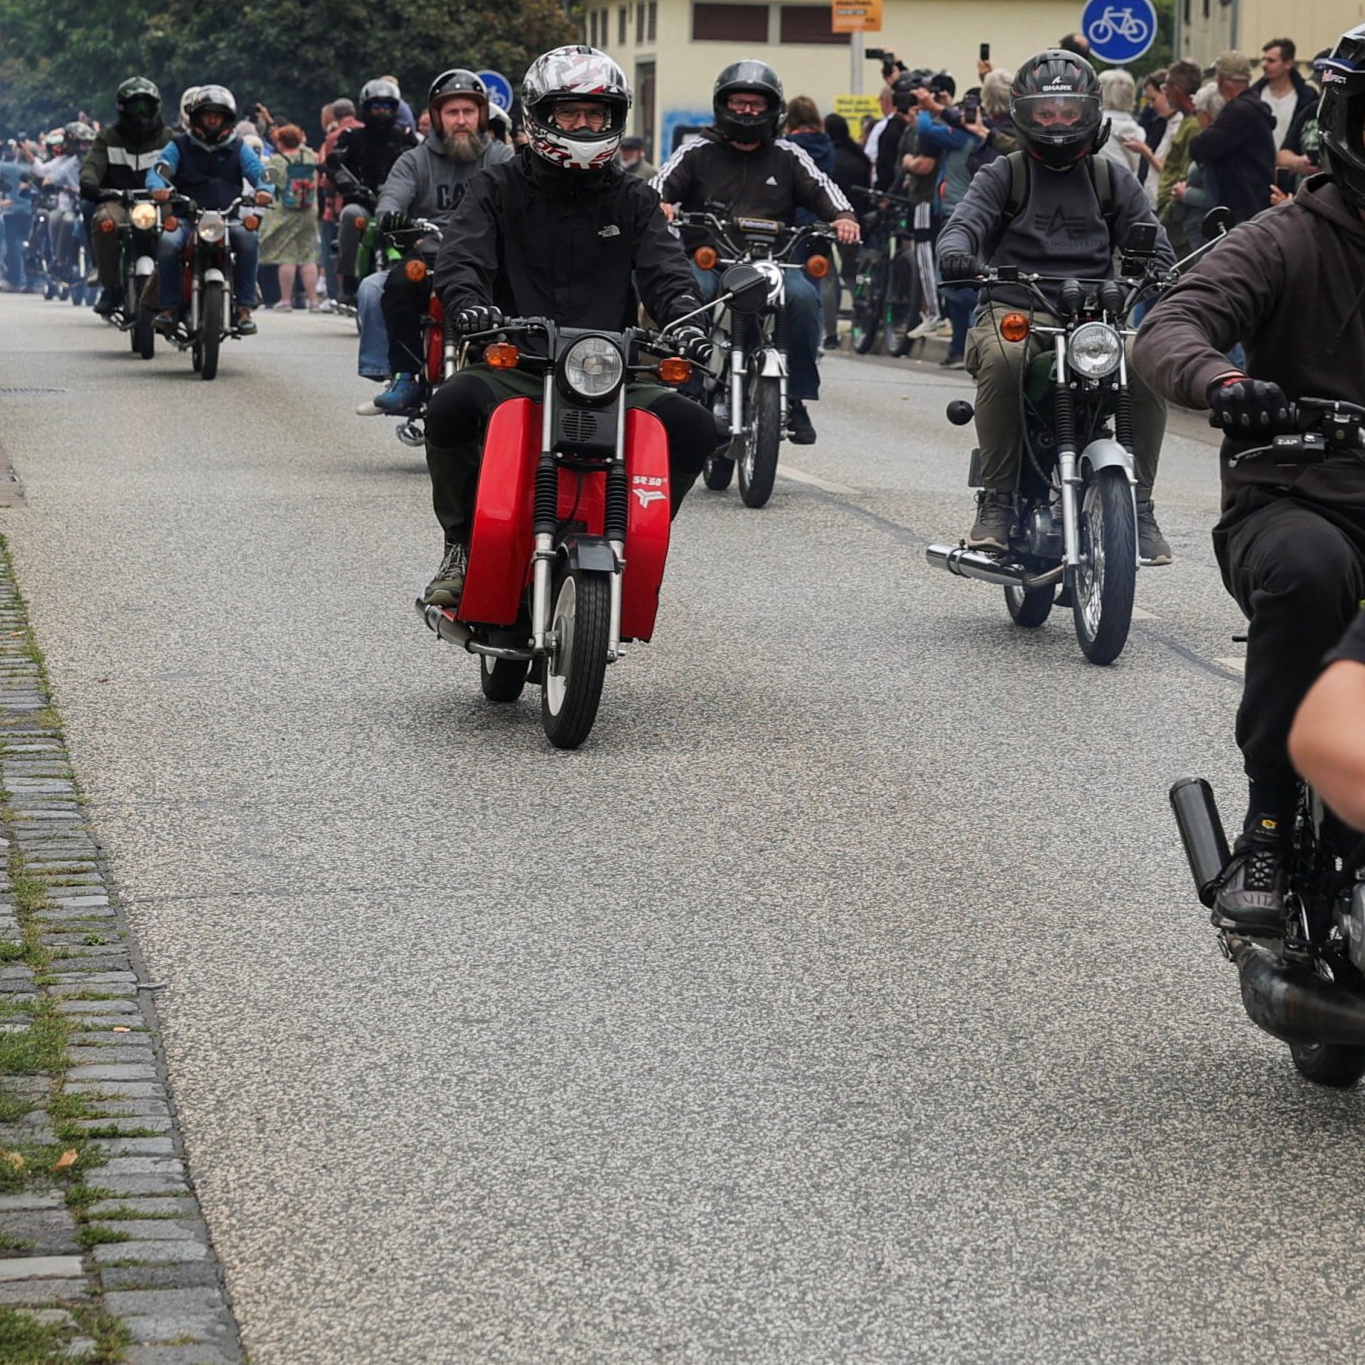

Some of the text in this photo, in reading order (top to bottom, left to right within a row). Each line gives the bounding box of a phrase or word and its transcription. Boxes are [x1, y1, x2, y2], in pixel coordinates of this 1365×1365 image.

[1042, 84, 1073, 92] SHARK
[436, 183, 469, 211] CA
[1277, 438, 1298, 446] ZAP
